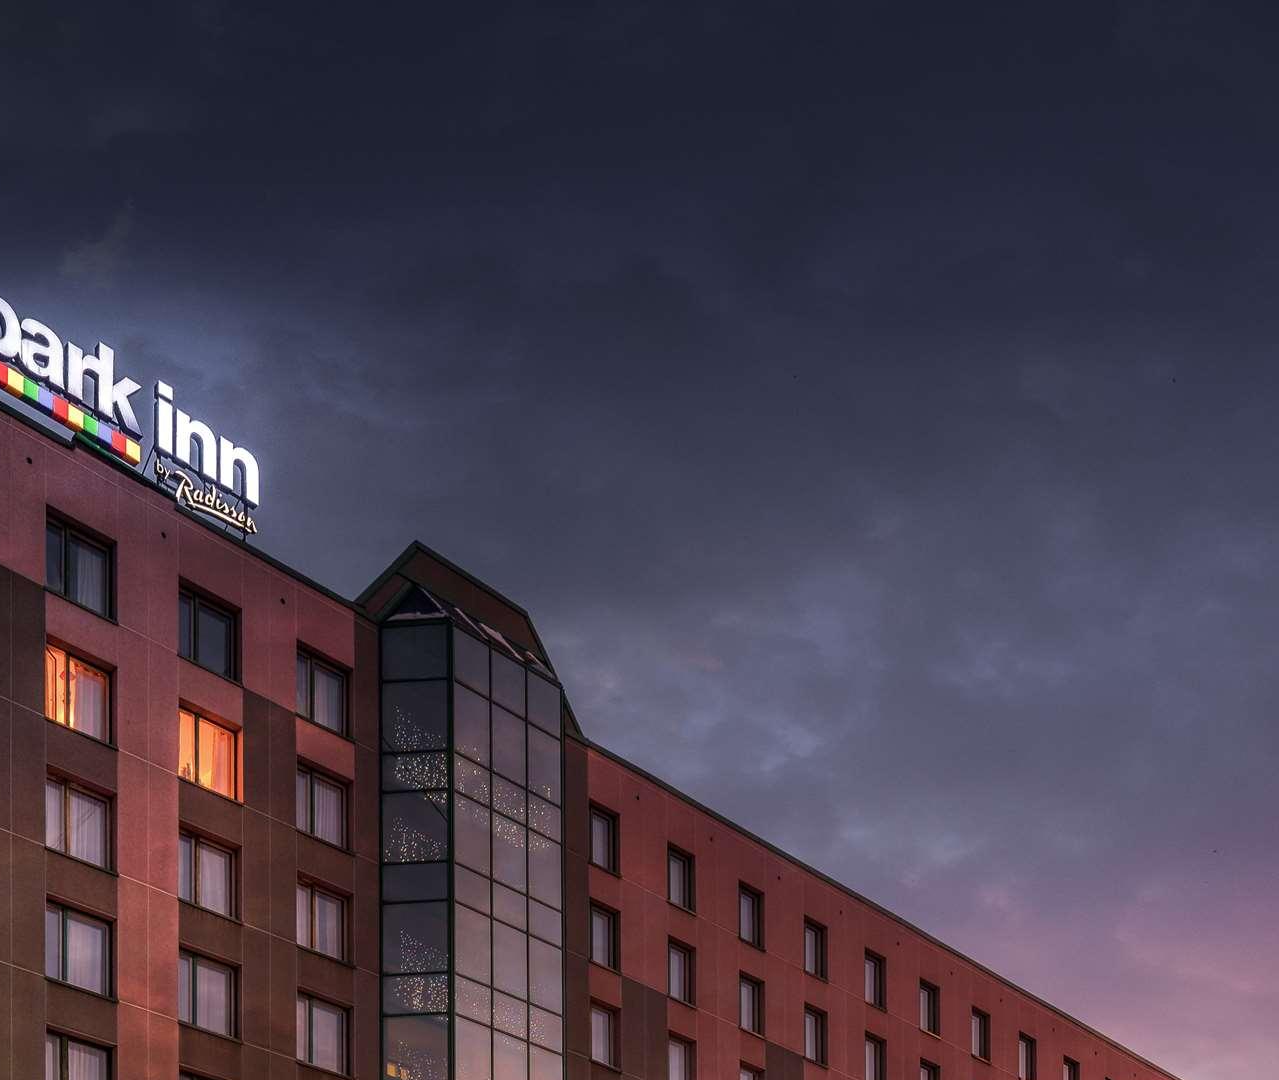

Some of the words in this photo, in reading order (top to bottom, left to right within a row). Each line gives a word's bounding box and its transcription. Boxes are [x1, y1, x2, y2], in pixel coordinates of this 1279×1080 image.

[154, 380, 260, 507] inn
[156, 459, 171, 482] by
[174, 469, 258, 534] Radisson
